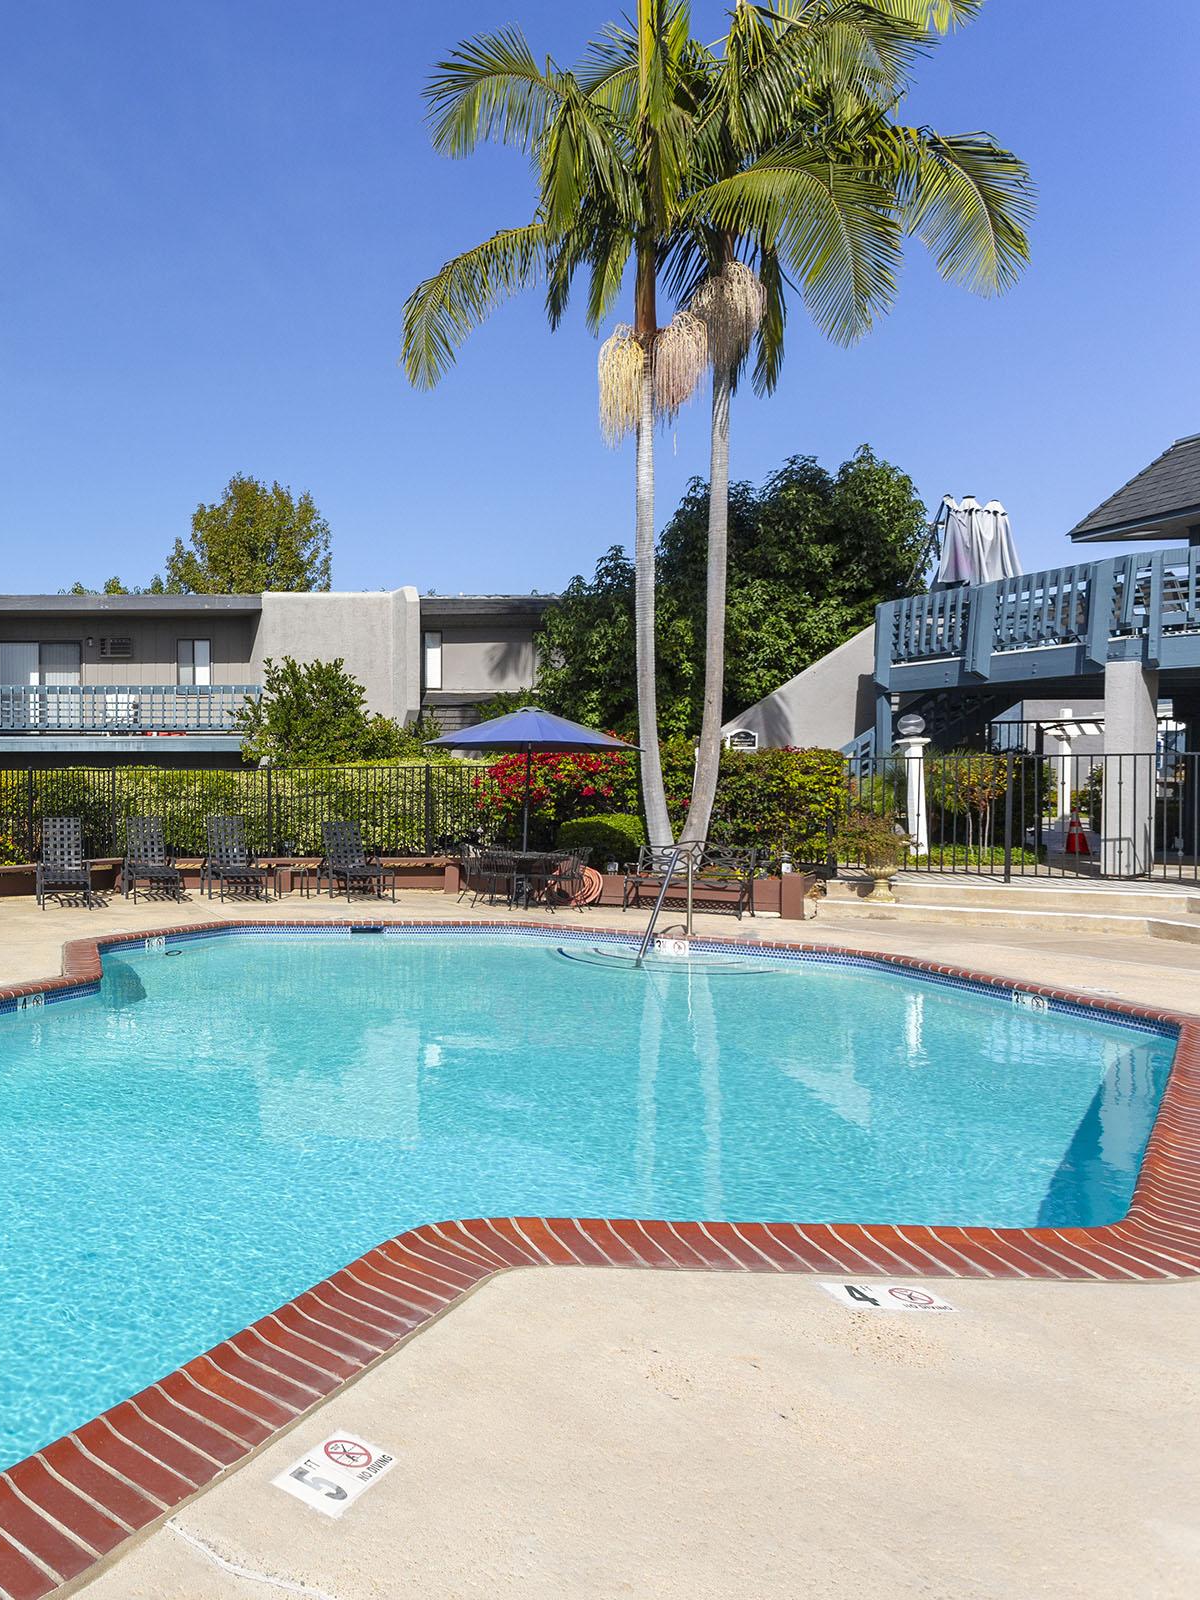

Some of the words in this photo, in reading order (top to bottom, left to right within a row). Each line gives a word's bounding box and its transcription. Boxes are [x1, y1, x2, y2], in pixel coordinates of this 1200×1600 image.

[844, 1285, 881, 1307] 4
[303, 1459, 321, 1471] FT
[356, 1470, 373, 1482] NO
[366, 1454, 394, 1476] DIVING
[289, 1467, 348, 1501] 5
